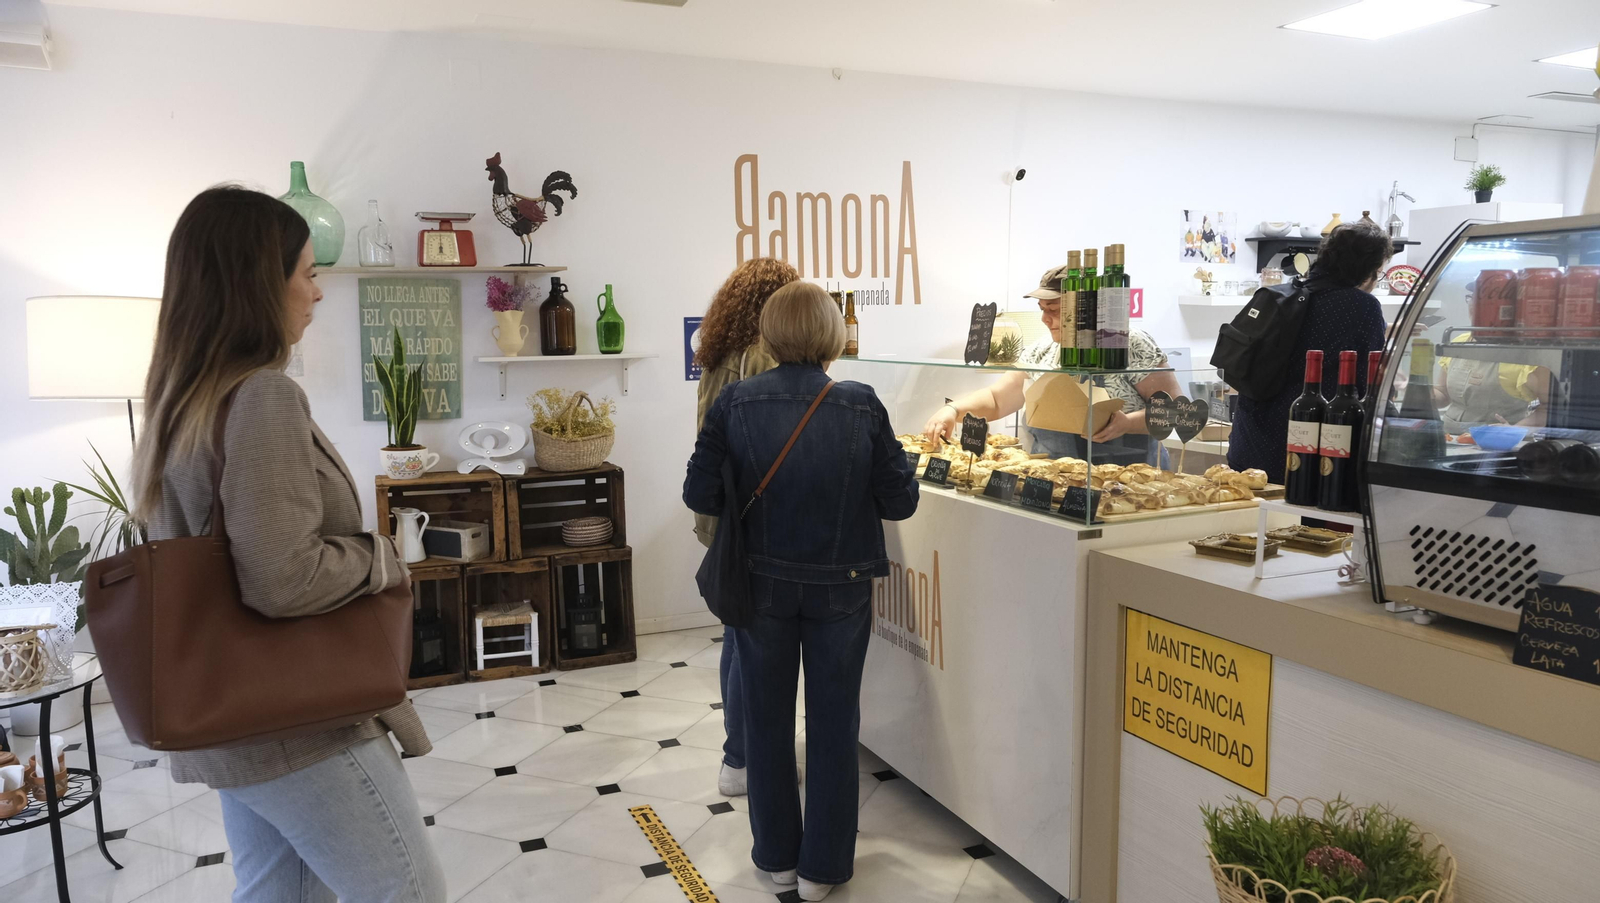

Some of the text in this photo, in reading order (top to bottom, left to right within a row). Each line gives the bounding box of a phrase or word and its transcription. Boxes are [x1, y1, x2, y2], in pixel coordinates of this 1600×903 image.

[367, 286, 450, 304] NO LLEGA ANTES
[852, 282, 890, 311] mpanada
[363, 308, 455, 327] EL QUE VA
[370, 331, 452, 356] MÁ RÁPIDO
[427, 363, 457, 382] SABE
[422, 388, 452, 413] VA
[871, 549, 944, 671] amonA
[1527, 591, 1573, 617] AGUA
[1524, 610, 1600, 639] REFRESCOS
[1147, 630, 1239, 683] MANTENGA
[1521, 633, 1579, 658] CERVEZA
[1531, 651, 1565, 670] LATA
[1136, 662, 1245, 726] LA DISTANCIA
[1132, 696, 1254, 768] DE SEGURIDAD
[646, 823, 710, 903] DISTANCIA DE SEGURIDAD
